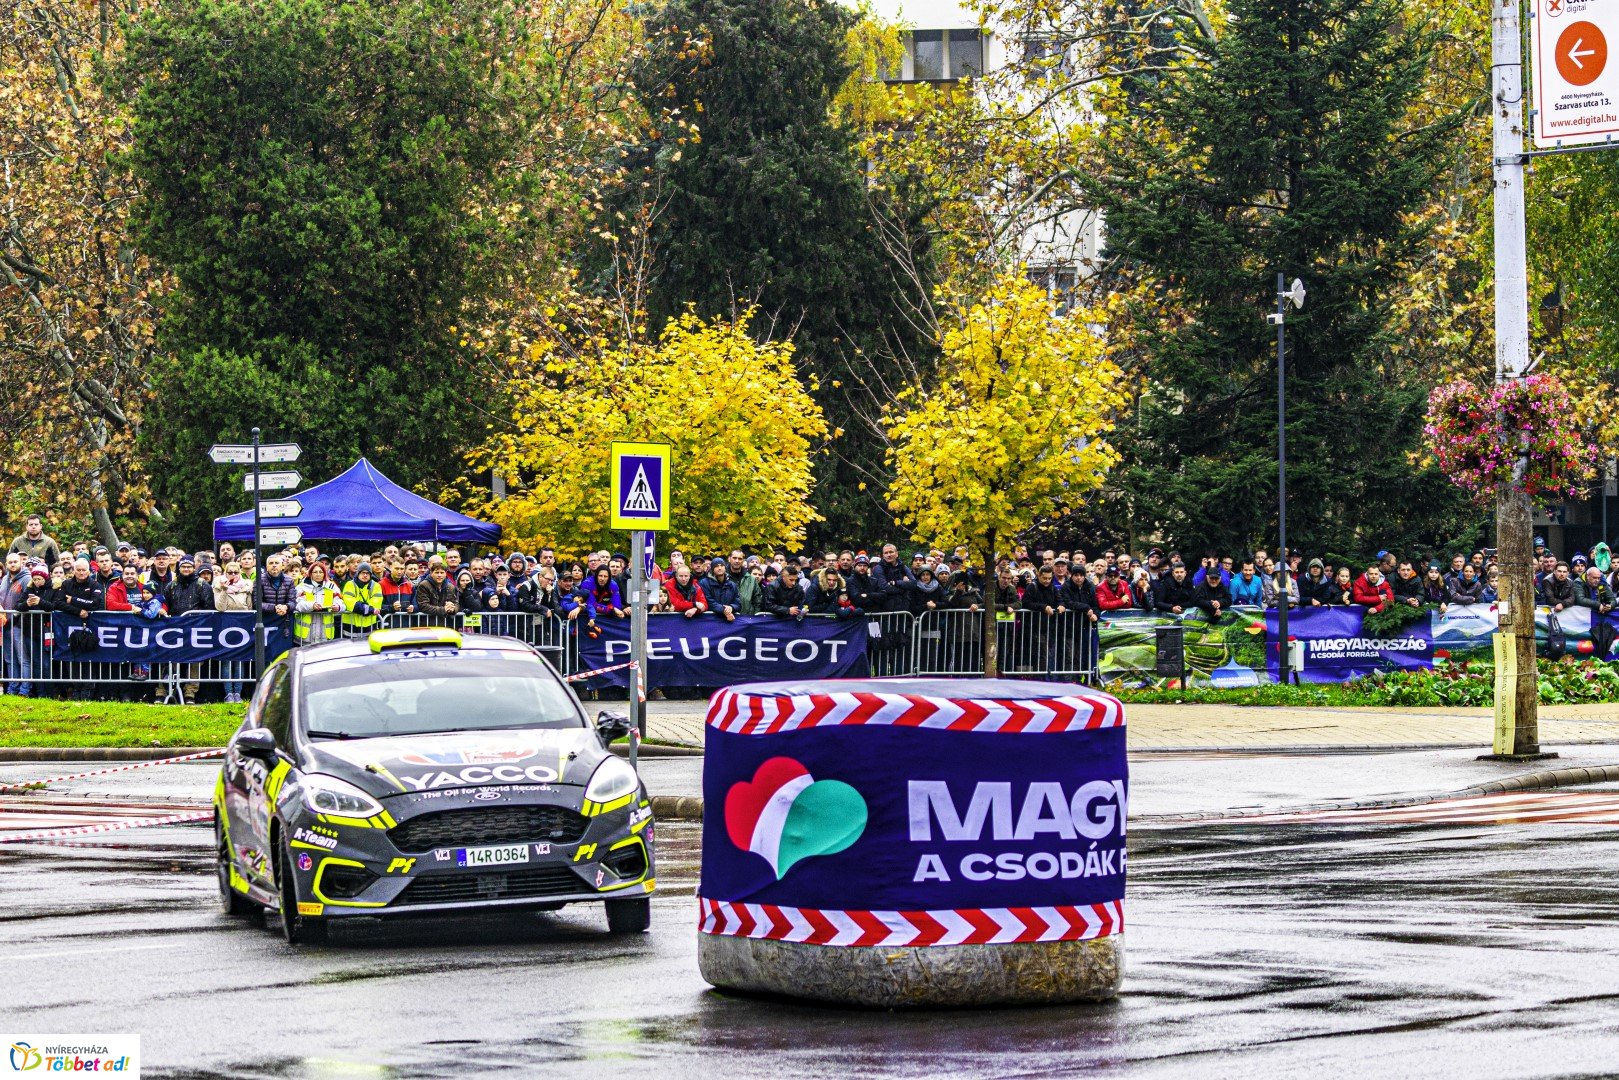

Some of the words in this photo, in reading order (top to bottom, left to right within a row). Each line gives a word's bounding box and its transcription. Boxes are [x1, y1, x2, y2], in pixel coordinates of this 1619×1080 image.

[1567, 4, 1587, 13] digital
[1554, 102, 1582, 110] Szarvas
[1583, 100, 1599, 108] utca
[1600, 98, 1612, 106] 13.
[1550, 114, 1617, 128] www.edigital.hu
[605, 636, 848, 663] PEUGEOT
[1310, 635, 1427, 651] MAGYARORSZÁG
[1318, 650, 1346, 659] CSODÁK
[1346, 650, 1380, 658] FORRÁSA
[401, 766, 559, 791] YACCO
[421, 791, 442, 800] The
[444, 788, 459, 797] Oil
[462, 787, 476, 795] for
[479, 785, 510, 794] World
[512, 784, 552, 792] Records
[294, 827, 338, 849] A-Team
[913, 854, 951, 882] A
[960, 840, 1116, 881] CSODÁK
